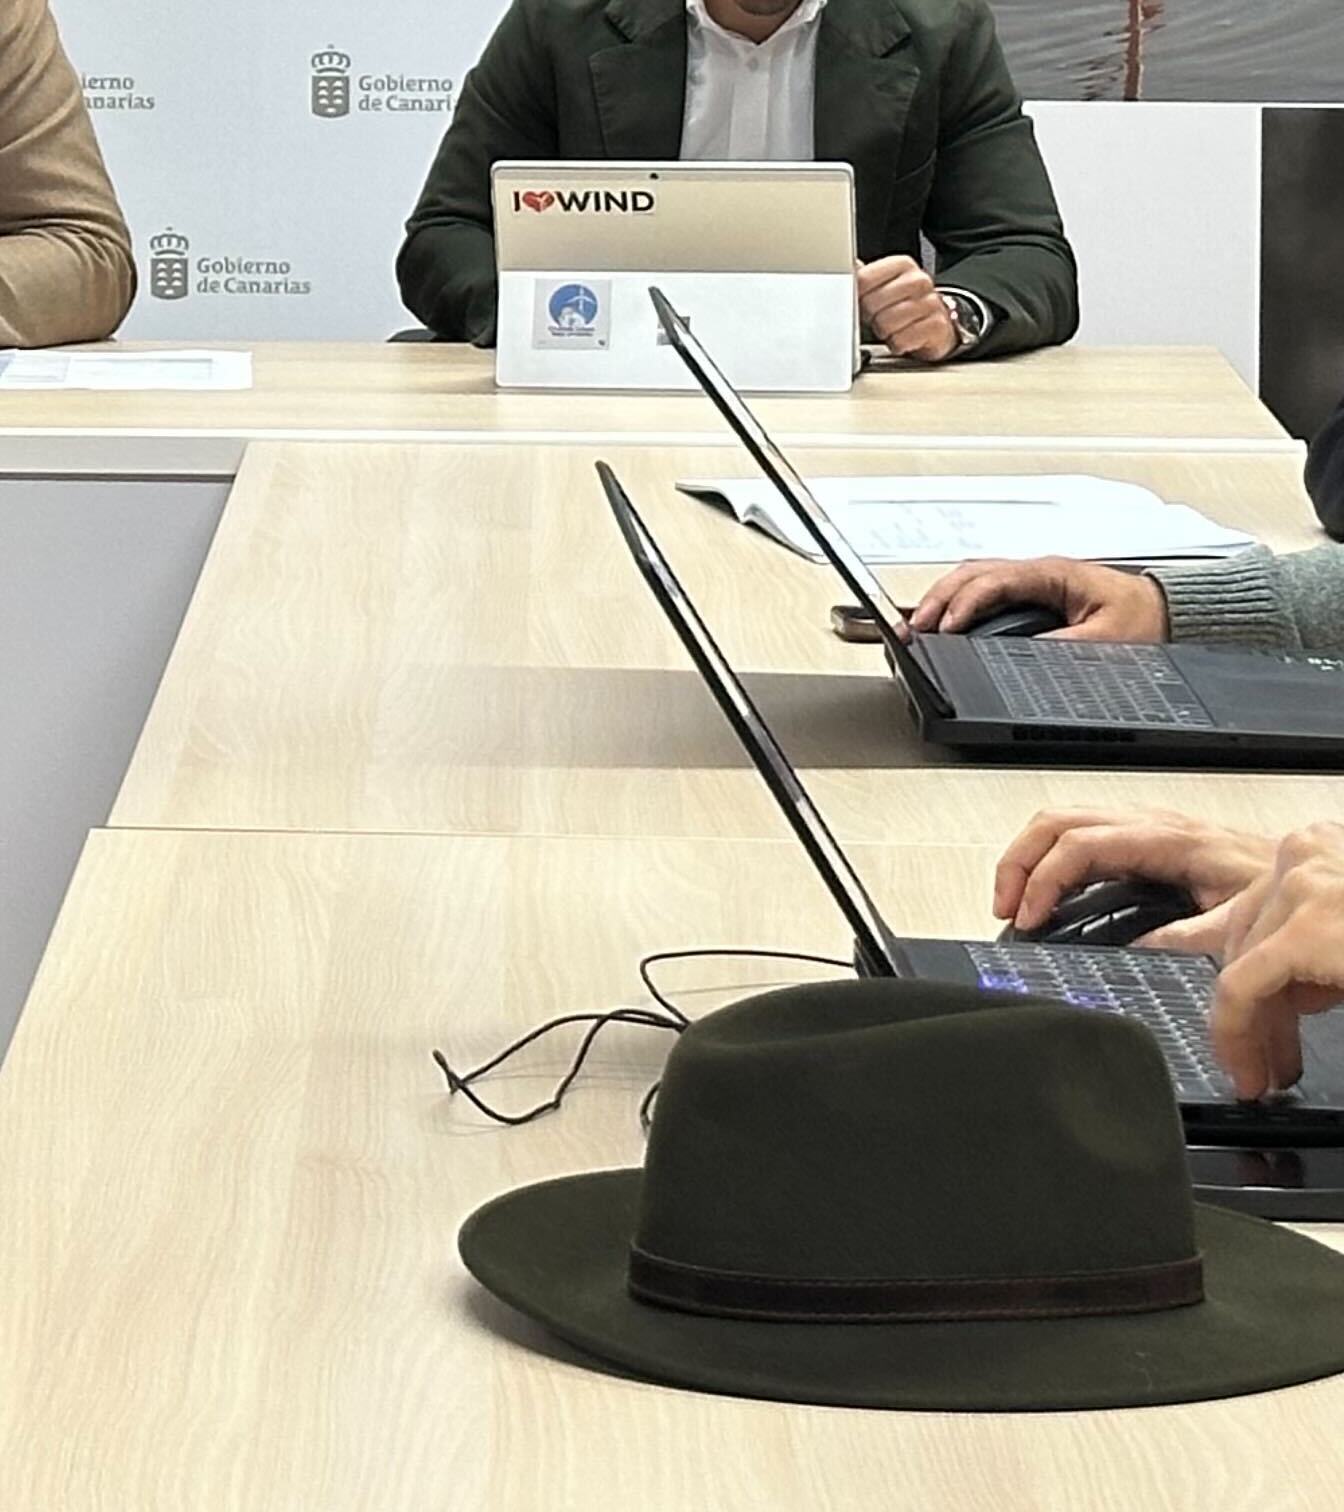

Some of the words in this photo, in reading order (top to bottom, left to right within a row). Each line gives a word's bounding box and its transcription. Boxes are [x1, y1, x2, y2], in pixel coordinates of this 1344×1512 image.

[358, 74, 453, 92] Gobierno
[358, 94, 382, 111] de
[386, 94, 452, 112] Canari
[554, 190, 655, 212] WIND
[196, 256, 291, 275] Gobierno
[196, 276, 221, 294] de
[223, 276, 311, 295] Canarias
